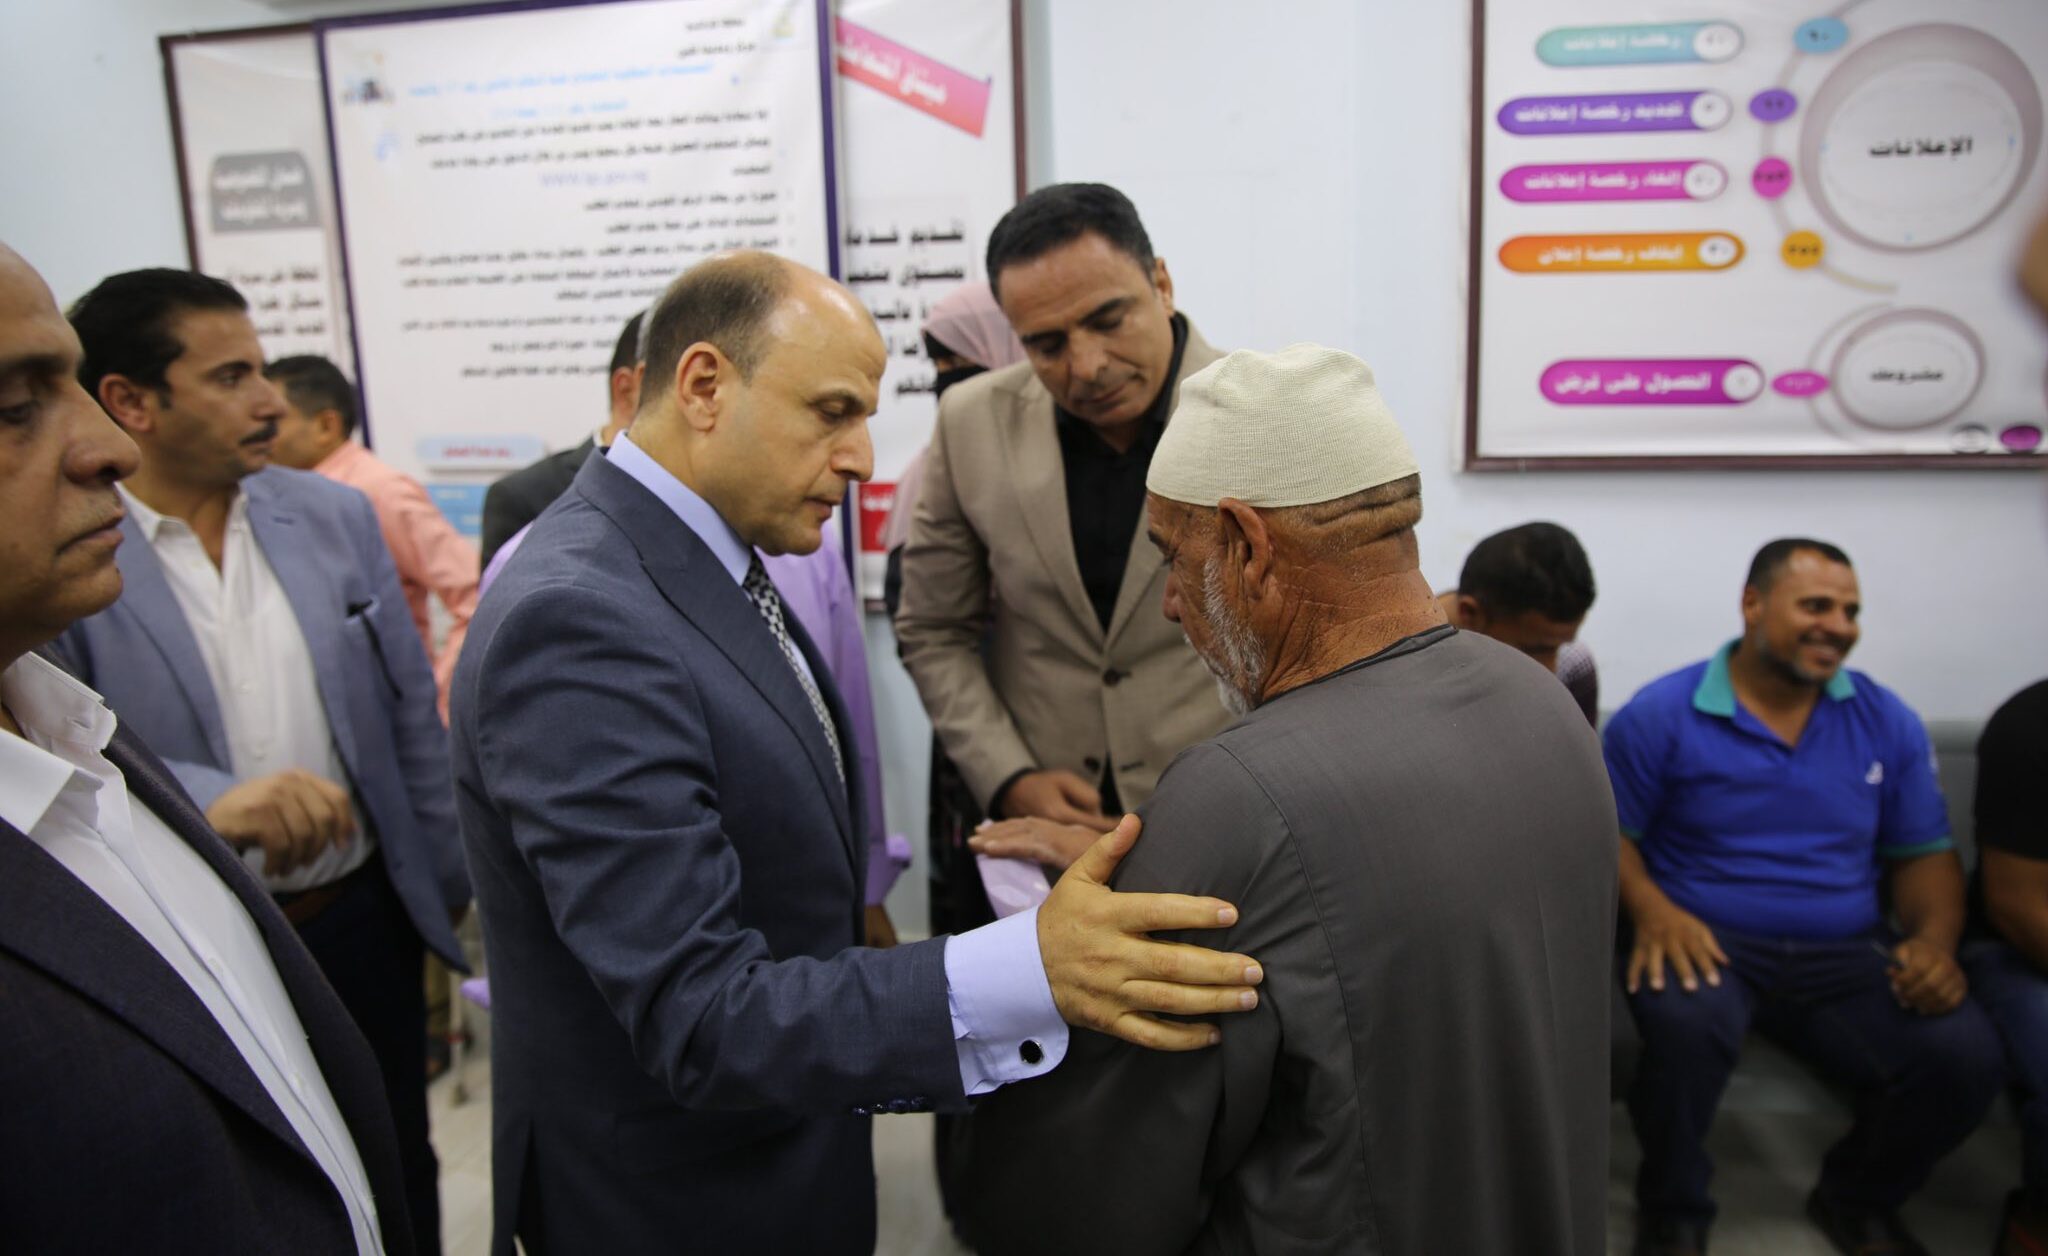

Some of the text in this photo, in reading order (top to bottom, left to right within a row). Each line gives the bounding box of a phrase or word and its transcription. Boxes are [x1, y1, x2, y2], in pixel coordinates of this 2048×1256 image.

[1514, 102, 1578, 124] إعلانات
[1581, 102, 1631, 122] رخصة
[1634, 100, 1684, 120] تجديد
[1868, 134, 1974, 161] الإعلانات
[1524, 171, 1586, 191] إعلانات
[1589, 171, 1637, 190] رخصة
[1586, 245, 1634, 265] رخصة
[1604, 371, 1642, 395] على
[1645, 371, 1713, 395] الحصول
